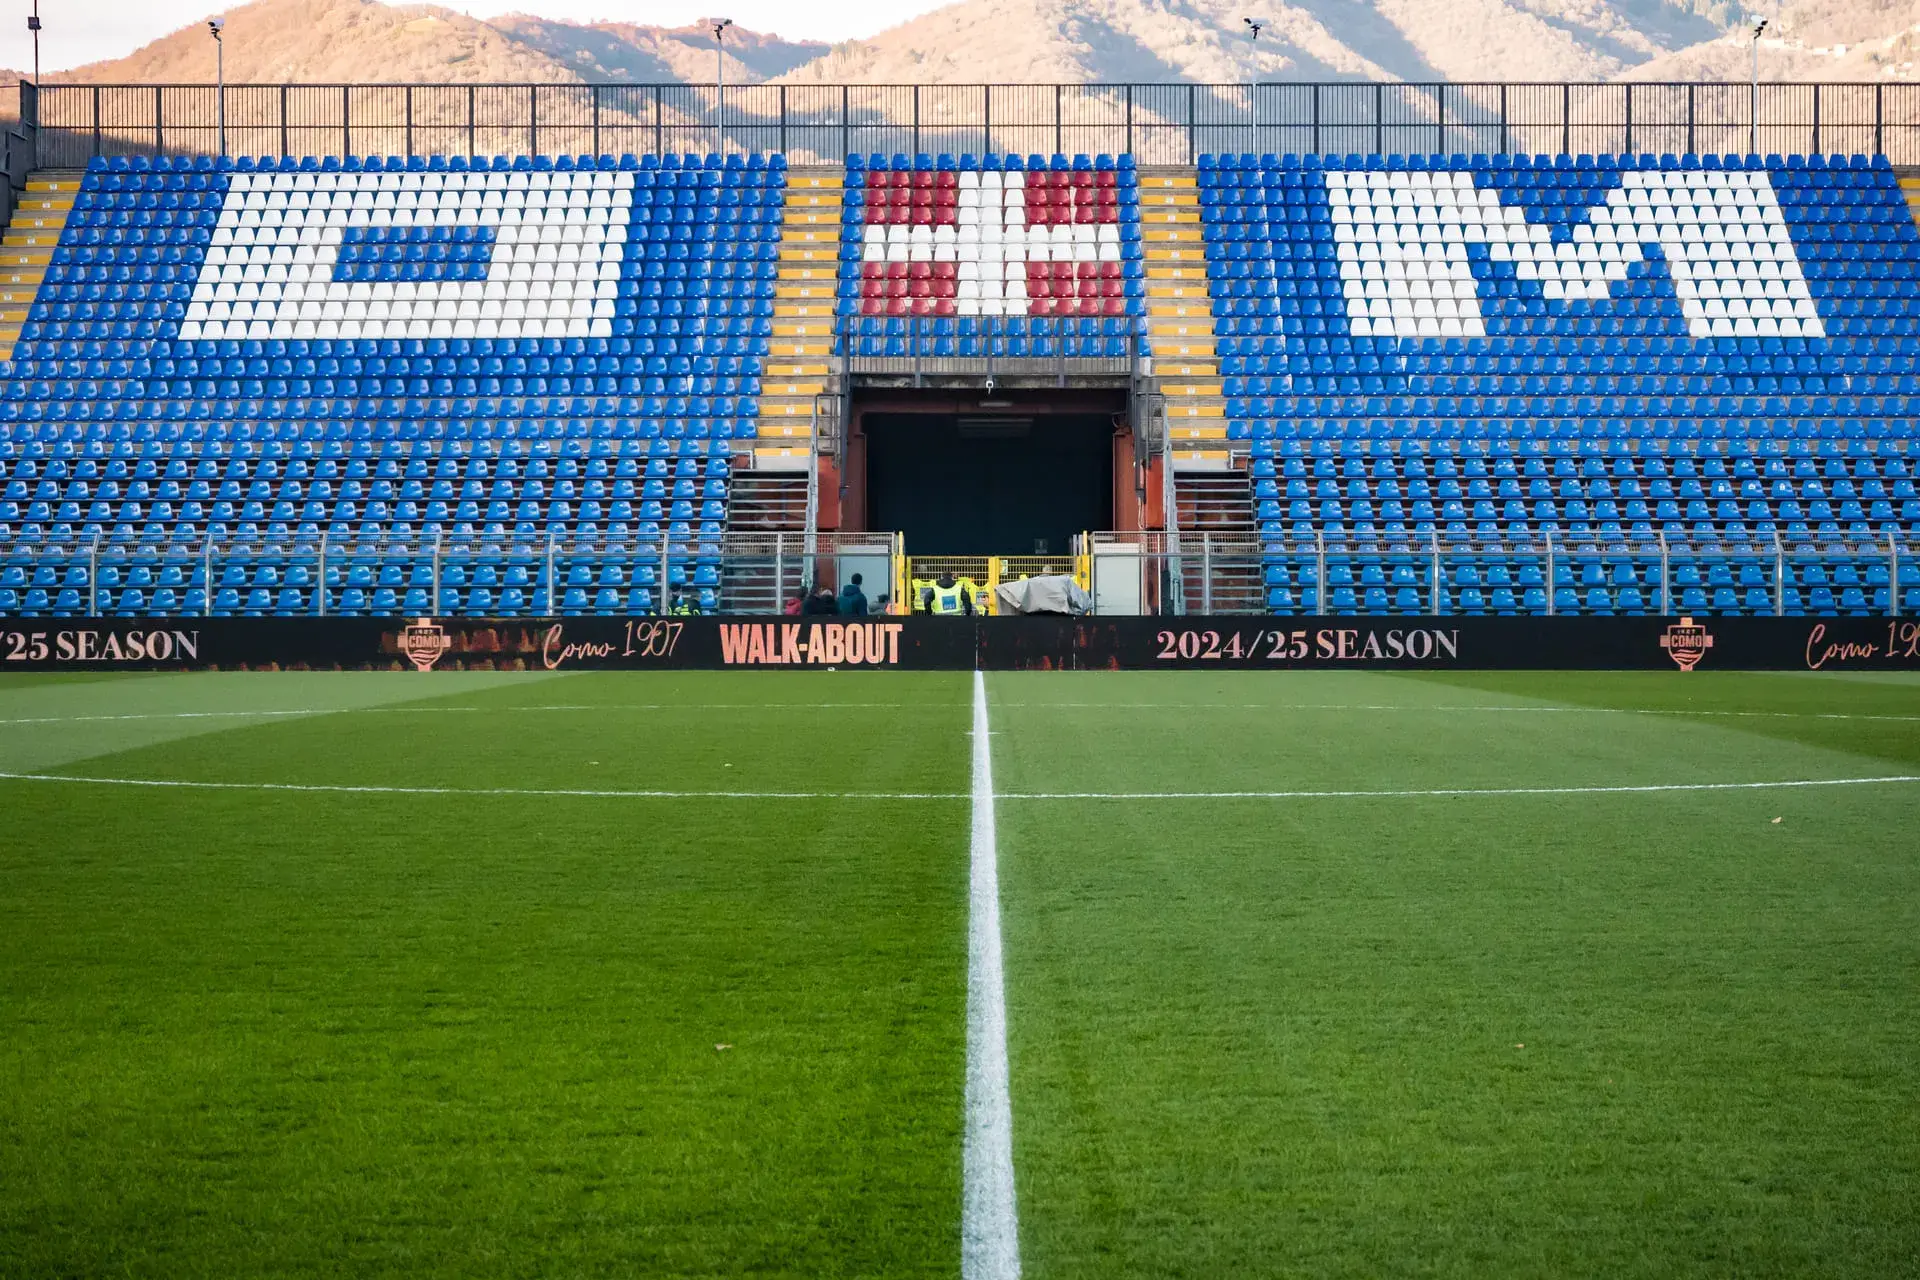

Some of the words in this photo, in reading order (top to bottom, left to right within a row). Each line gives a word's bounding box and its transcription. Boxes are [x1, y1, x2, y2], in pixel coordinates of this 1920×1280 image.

[1325, 171, 1827, 337] M
[0, 631, 49, 660] 25
[56, 630, 200, 660] SEASON
[409, 635, 439, 647] COMO
[543, 624, 616, 669] Como
[622, 620, 684, 656] 1907
[719, 624, 903, 664] WALK-ABOUT
[1156, 630, 1309, 659] 2024/25
[1316, 630, 1460, 659] SEASON
[1671, 634, 1702, 647] COMO
[1806, 623, 1879, 669] Como
